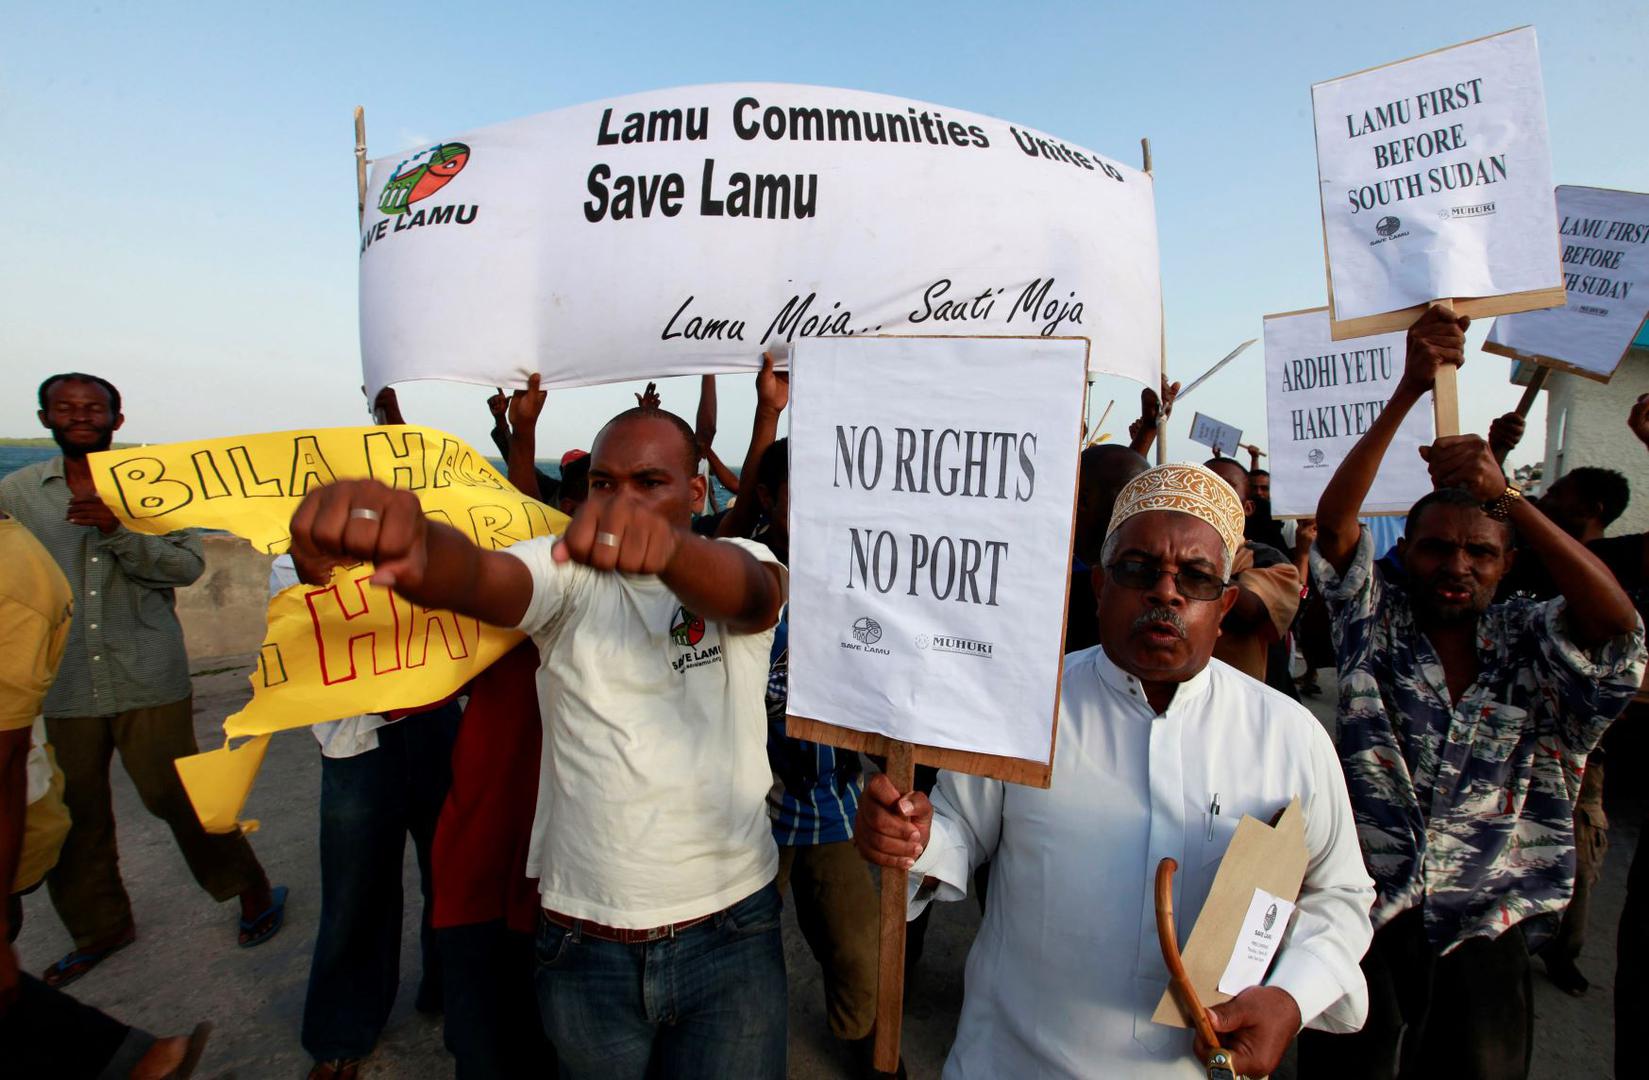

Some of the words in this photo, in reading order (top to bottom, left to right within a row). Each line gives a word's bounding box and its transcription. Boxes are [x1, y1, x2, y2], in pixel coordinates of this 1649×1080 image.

[1346, 98, 1411, 139] LAMU
[1416, 78, 1483, 119] FIRST
[597, 107, 708, 145] Lamu
[733, 97, 990, 148] Communities
[1010, 126, 1094, 170] Unite
[1093, 155, 1124, 182] to
[1373, 123, 1467, 170] BEFORE
[584, 163, 685, 223] Save
[700, 158, 818, 219] Lamu
[1347, 174, 1424, 214] SOUTH
[1430, 154, 1508, 193] SUDAN
[394, 204, 479, 232] LAMU
[1558, 216, 1605, 239] LAMU
[1561, 245, 1625, 270] BEFORE
[661, 295, 744, 341] Lamu
[909, 279, 1003, 323] Sauti
[1007, 277, 1083, 336] Moja
[1579, 275, 1634, 300] SUDAN
[1282, 354, 1339, 392] ARDHI
[1341, 346, 1392, 385] YETU
[1291, 405, 1339, 441] HAKI
[110, 435, 338, 520] BILA
[833, 425, 883, 491] NO
[891, 427, 1038, 502] RIGHTS
[846, 528, 898, 594] NO
[906, 533, 1009, 607] PORT
[840, 641, 862, 651] SAVE
[864, 645, 890, 655] LAMU
[933, 636, 993, 654] MUHURI
